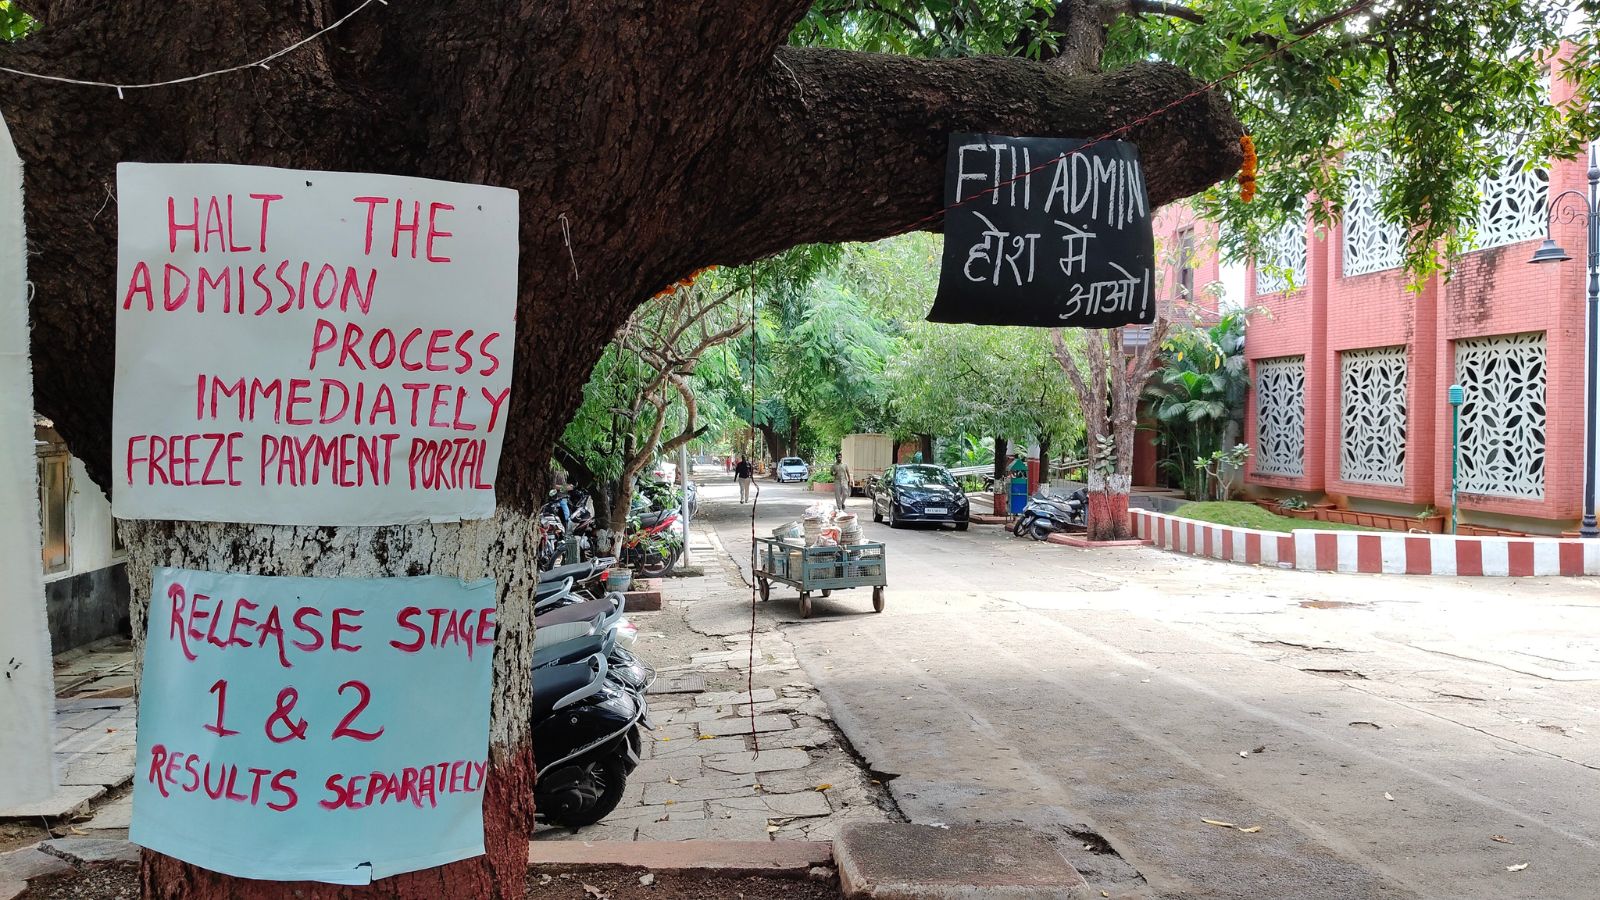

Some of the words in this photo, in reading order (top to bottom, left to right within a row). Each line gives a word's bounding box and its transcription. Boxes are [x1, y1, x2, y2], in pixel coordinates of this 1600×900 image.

[956, 143, 1030, 211] FTII
[1044, 151, 1145, 230] ADMIN
[167, 193, 284, 254] HALT
[353, 196, 455, 263] THE
[963, 210, 1041, 286] होश
[1053, 218, 1097, 276] में
[122, 259, 378, 316] ADMISSION
[1058, 261, 1150, 320] आओ!
[309, 318, 501, 377] PROCESS
[197, 373, 511, 433] IMMEDIATELY
[126, 431, 244, 487] FREEZE
[260, 433, 401, 488] PAYMENT
[408, 438, 493, 491] PORTAL
[167, 582, 365, 668] RELEASE
[389, 606, 497, 661] STAGE
[204, 679, 240, 738] 1
[264, 685, 309, 744] &
[331, 679, 385, 742] 2
[148, 743, 299, 812] RESULTS
[317, 759, 487, 809] SEPARATELY
